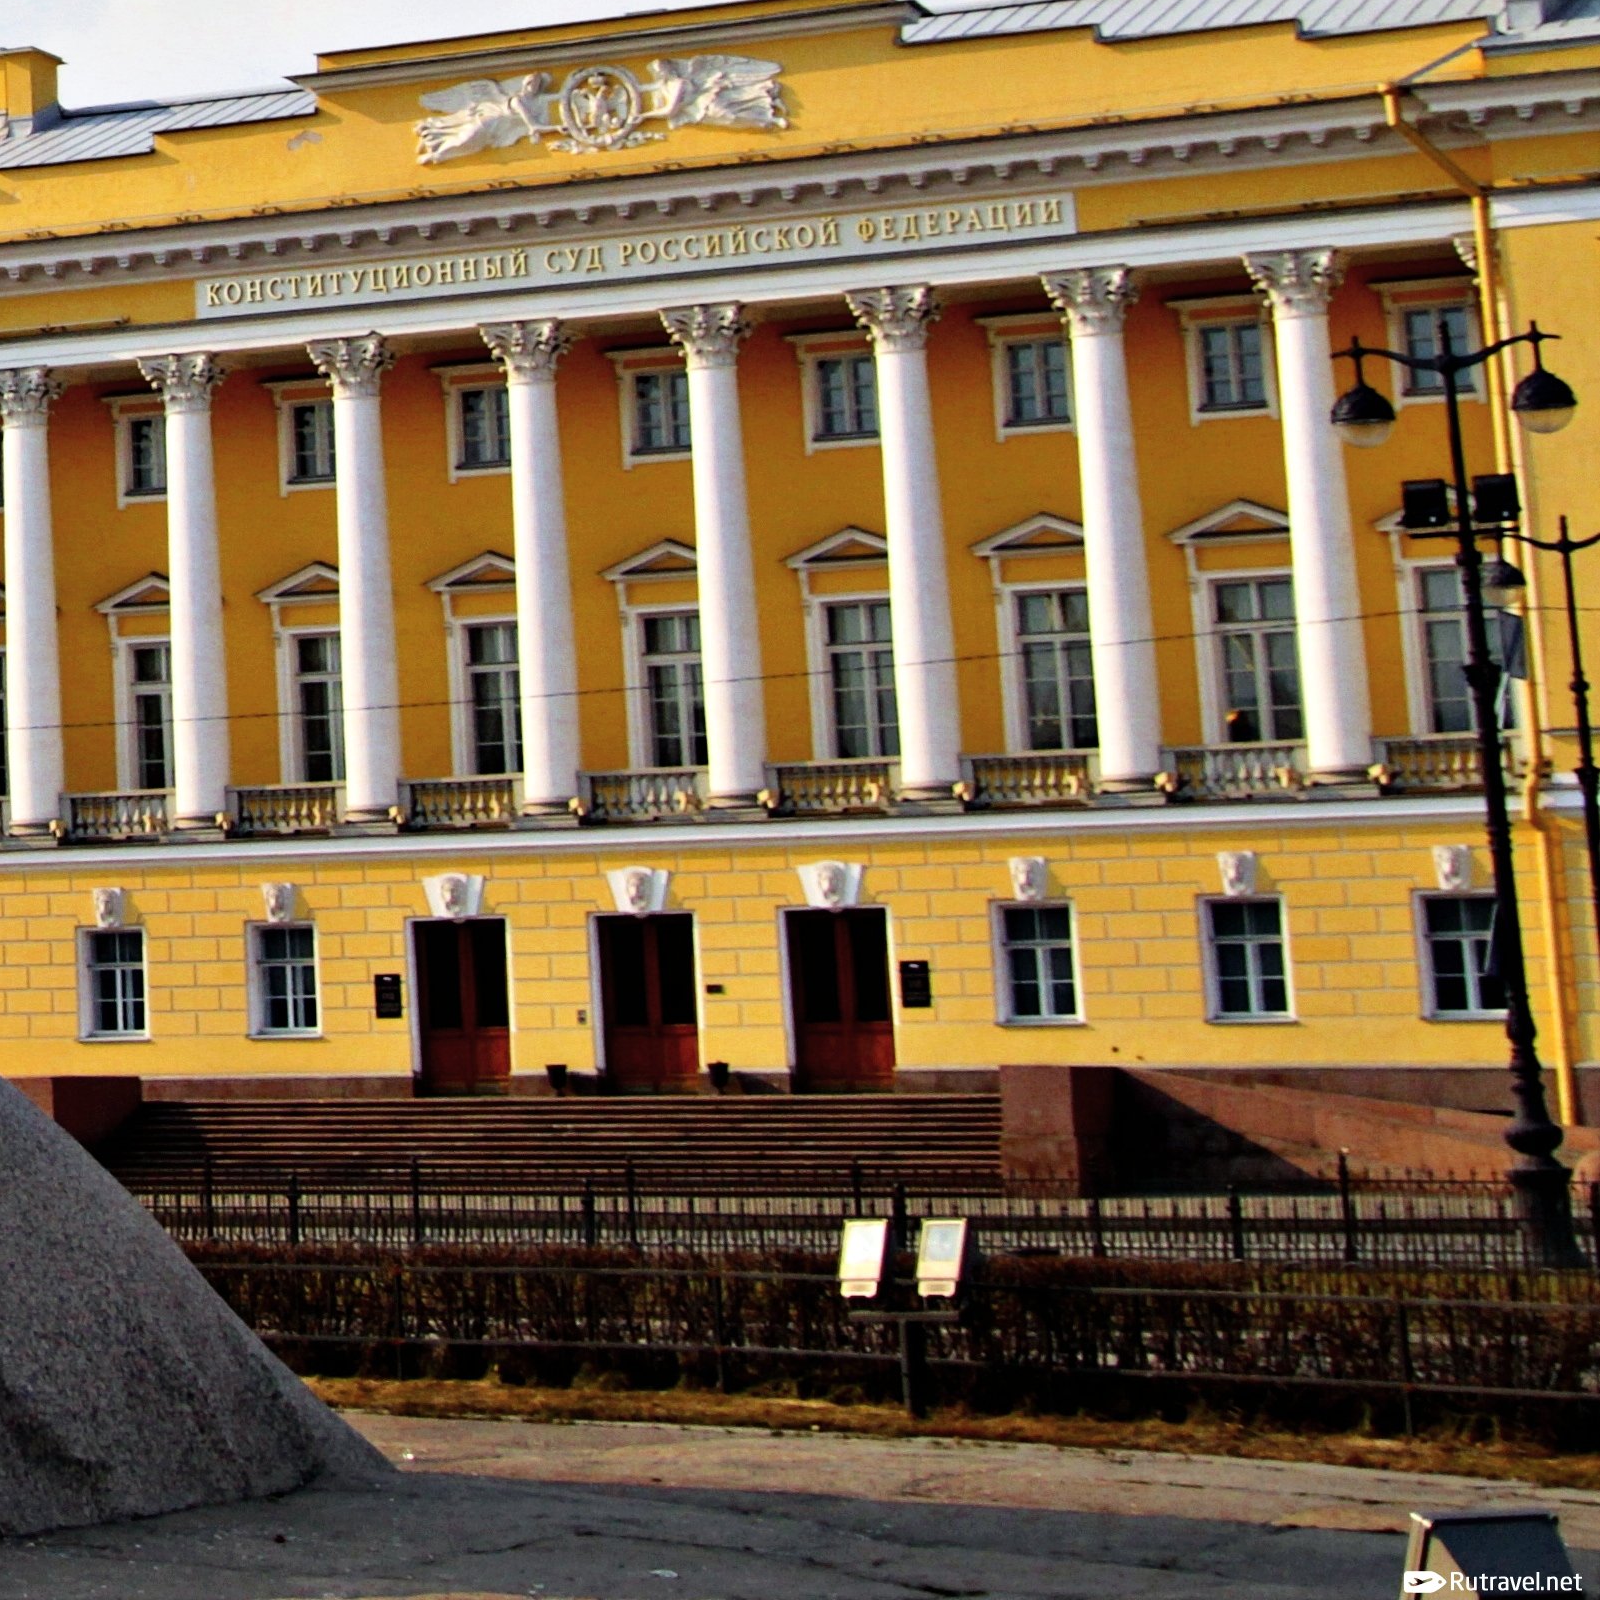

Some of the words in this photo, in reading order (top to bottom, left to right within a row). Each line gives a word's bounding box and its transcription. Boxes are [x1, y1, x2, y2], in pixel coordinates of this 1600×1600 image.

[205, 248, 530, 307] КОНСТИТУЦИОННЫЙ
[542, 245, 605, 275] СУД
[617, 217, 840, 267] РОССИЙСКОЙ
[854, 199, 1065, 244] ФЕДЕРАЦИИ
